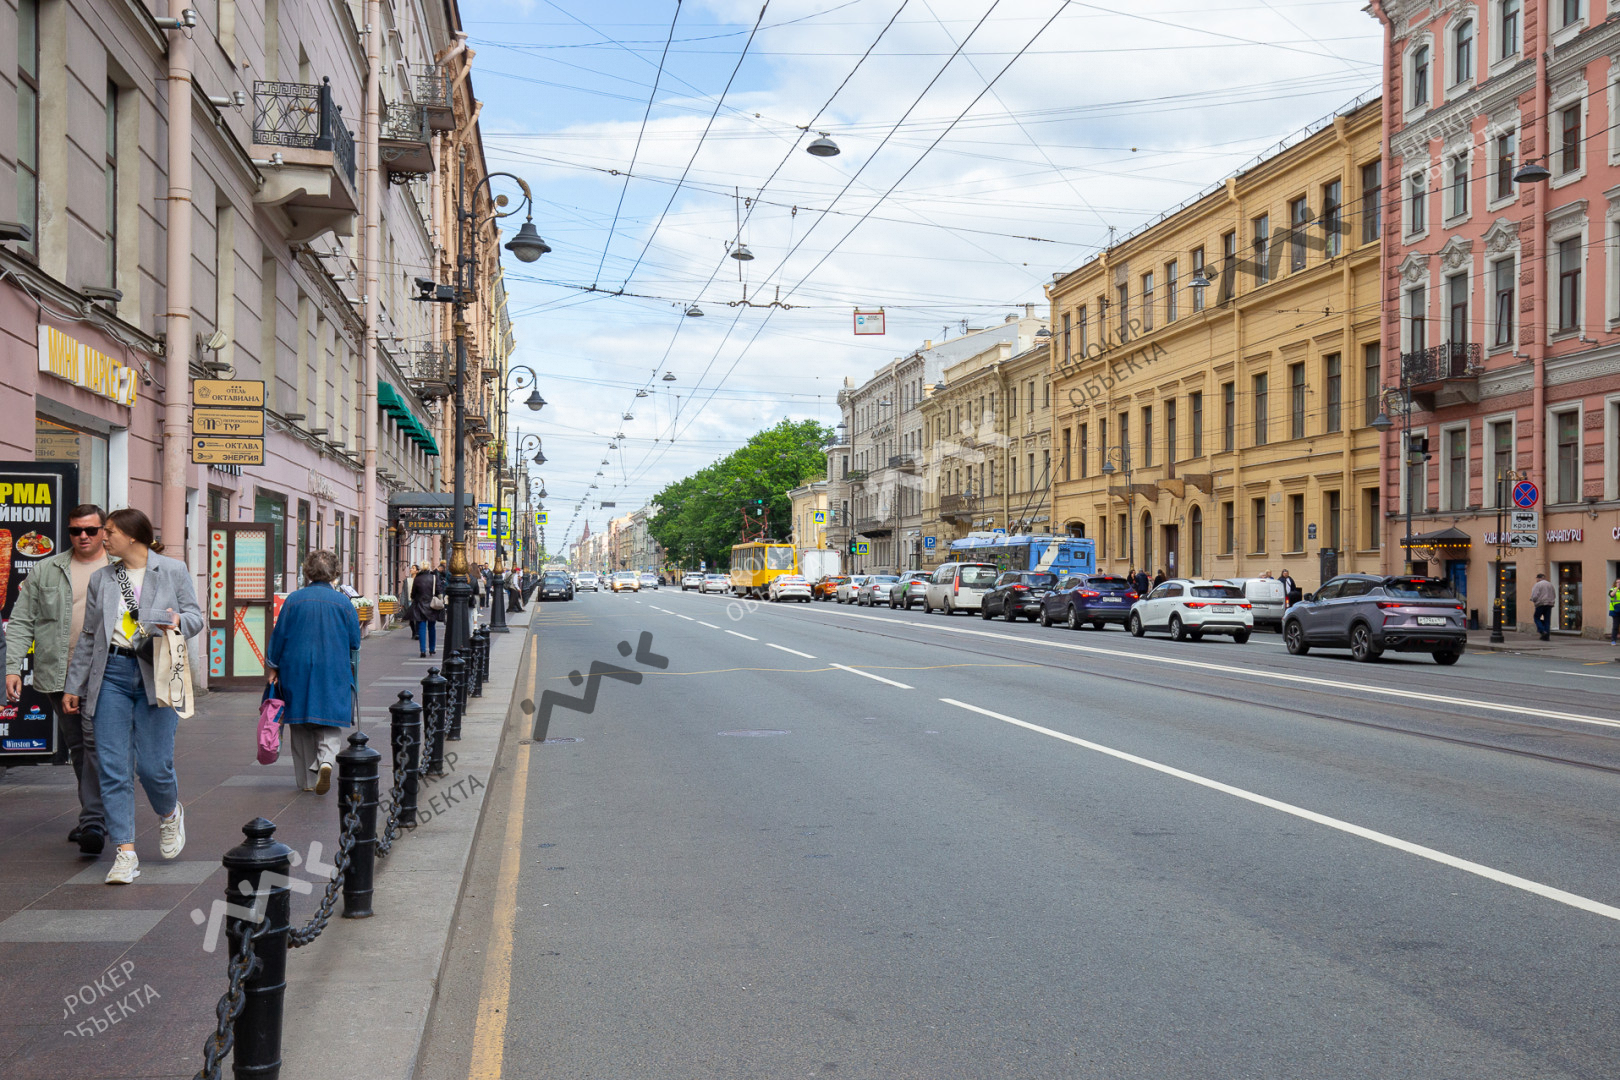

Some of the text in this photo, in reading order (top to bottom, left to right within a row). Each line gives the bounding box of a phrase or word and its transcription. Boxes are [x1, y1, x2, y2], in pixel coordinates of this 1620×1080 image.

[84, 344, 122, 402] МАРКЕТ
[212, 394, 260, 402] ОКТАВИАНА
[224, 423, 240, 431] ТУР
[225, 442, 259, 450] ОКТАВА
[1483, 532, 1512, 544] ХИНАЛ
[1546, 529, 1582, 543] ХАЧАПУРИ
[6, 740, 30, 748] Winston
